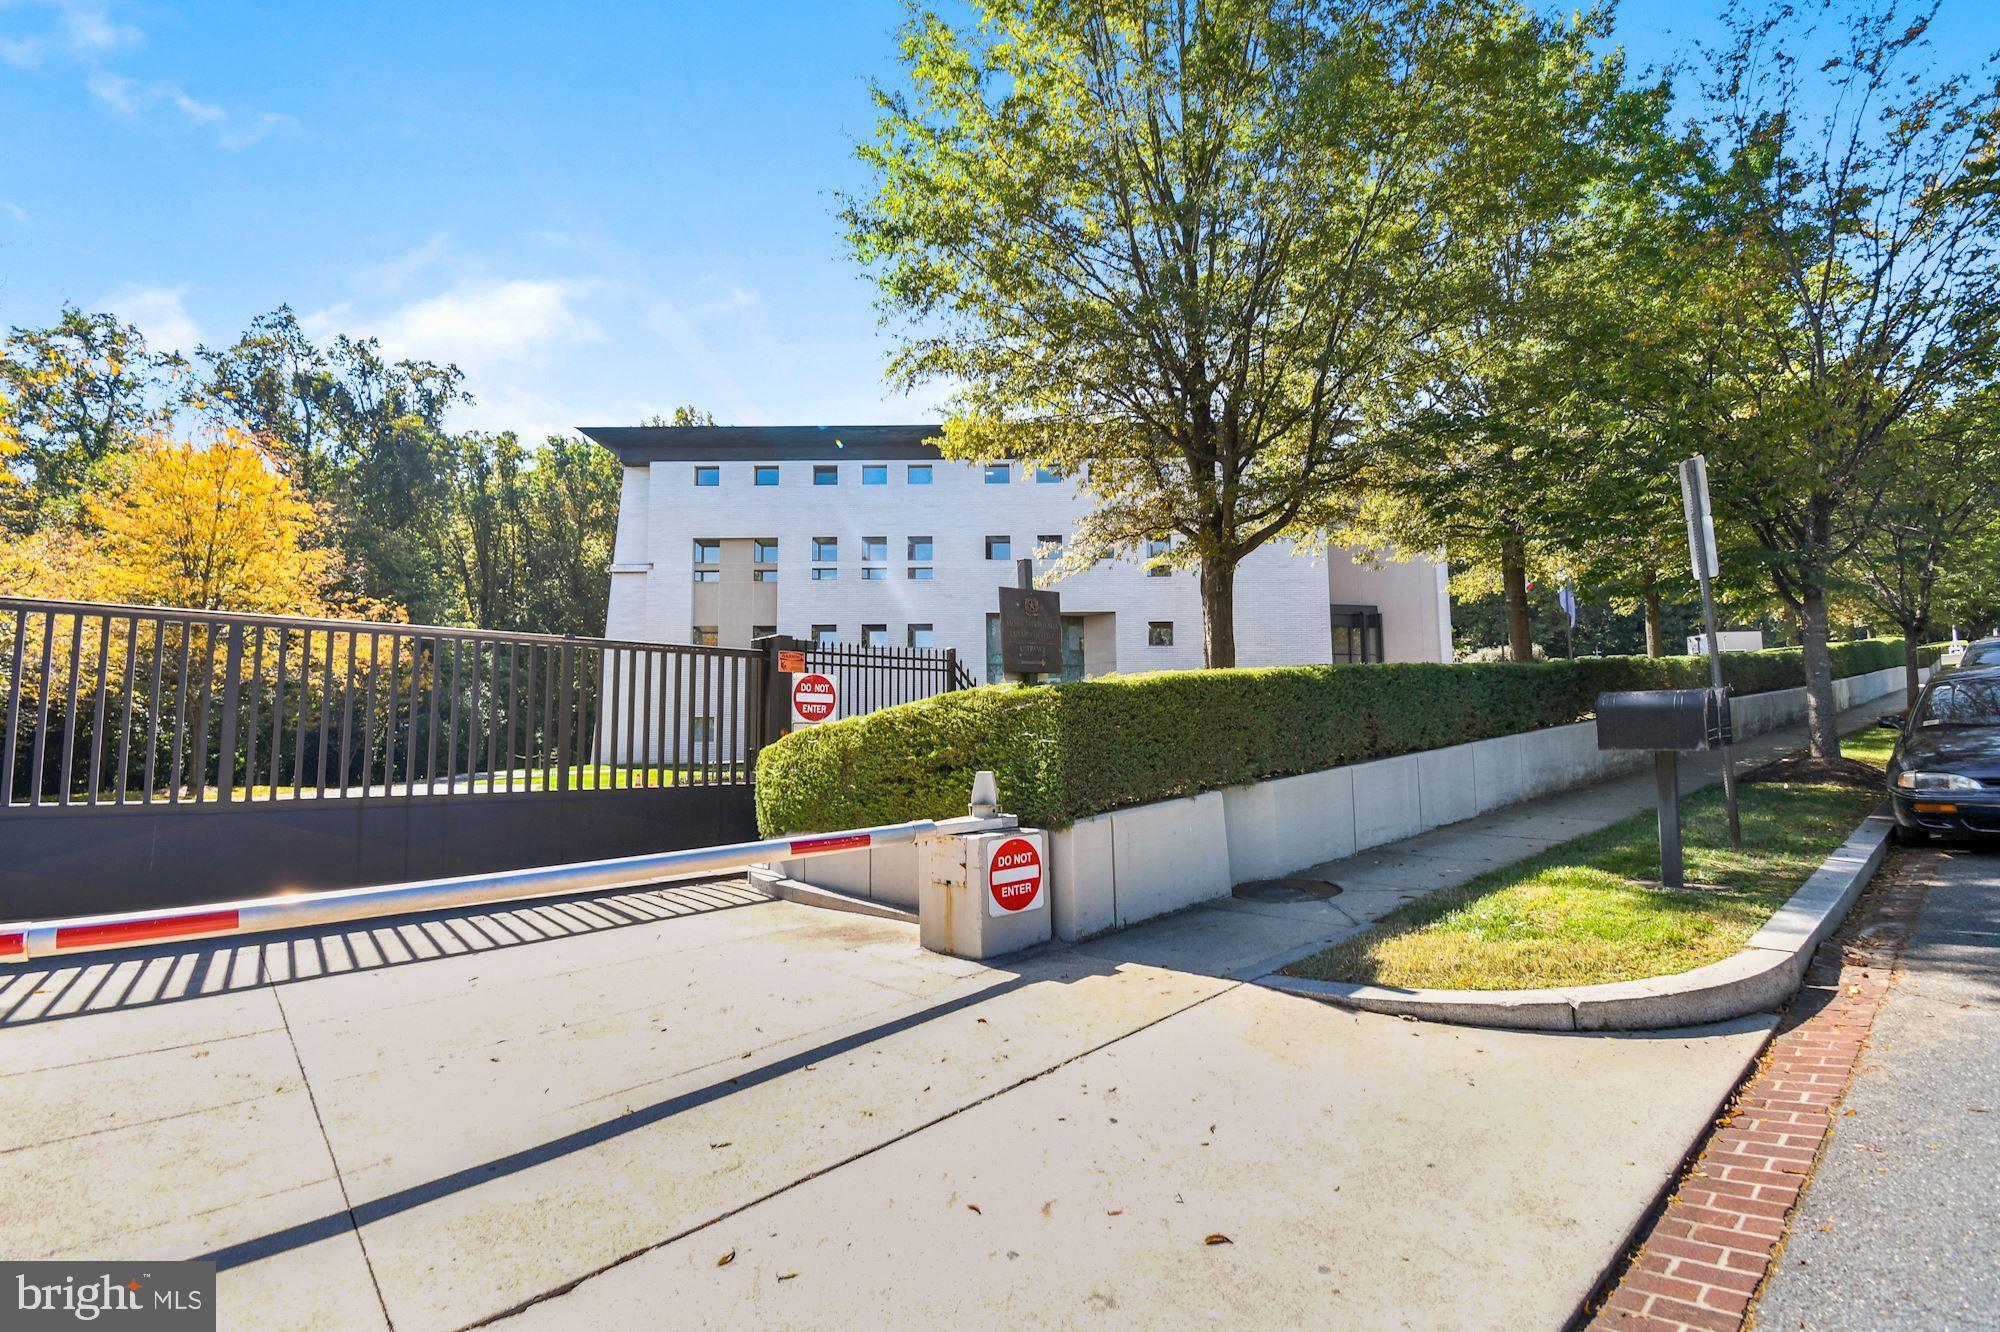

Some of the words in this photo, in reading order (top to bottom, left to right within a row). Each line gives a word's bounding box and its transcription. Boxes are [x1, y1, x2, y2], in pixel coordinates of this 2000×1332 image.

[800, 683, 811, 692] DO
[815, 684, 829, 693] NOT
[802, 704, 827, 714] ENTER
[998, 855, 1011, 867] DO
[1014, 852, 1032, 864] NOT
[1002, 883, 1032, 898] ENTER
